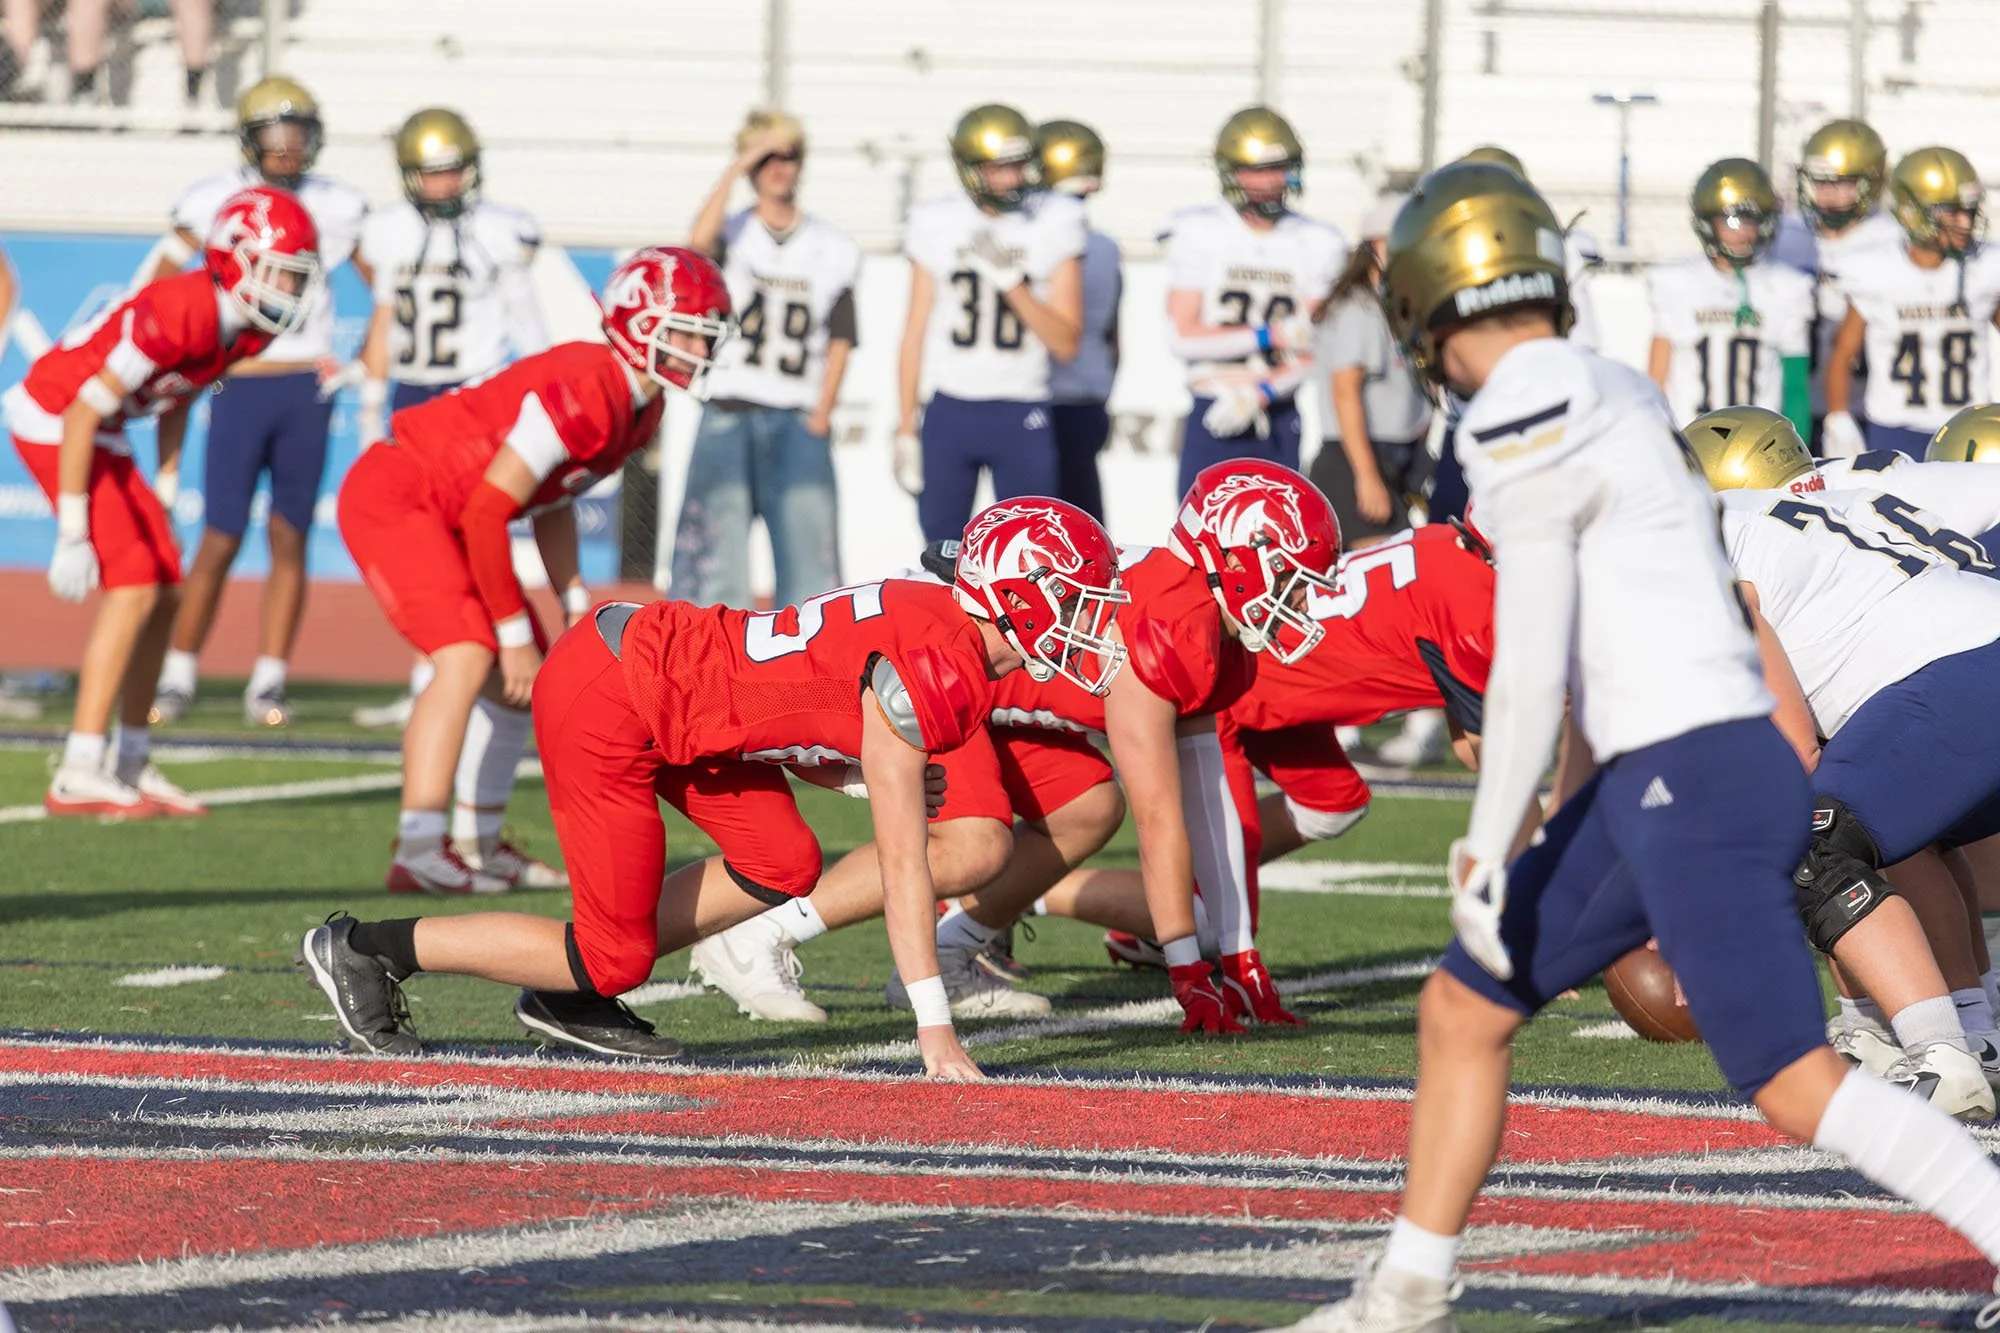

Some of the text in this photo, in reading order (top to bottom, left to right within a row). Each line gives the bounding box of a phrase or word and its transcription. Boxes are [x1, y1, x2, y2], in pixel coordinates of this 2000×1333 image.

[396, 288, 463, 367] 92
[738, 291, 812, 376] 49
[1693, 335, 1760, 414] 10
[1890, 330, 1974, 405] 48
